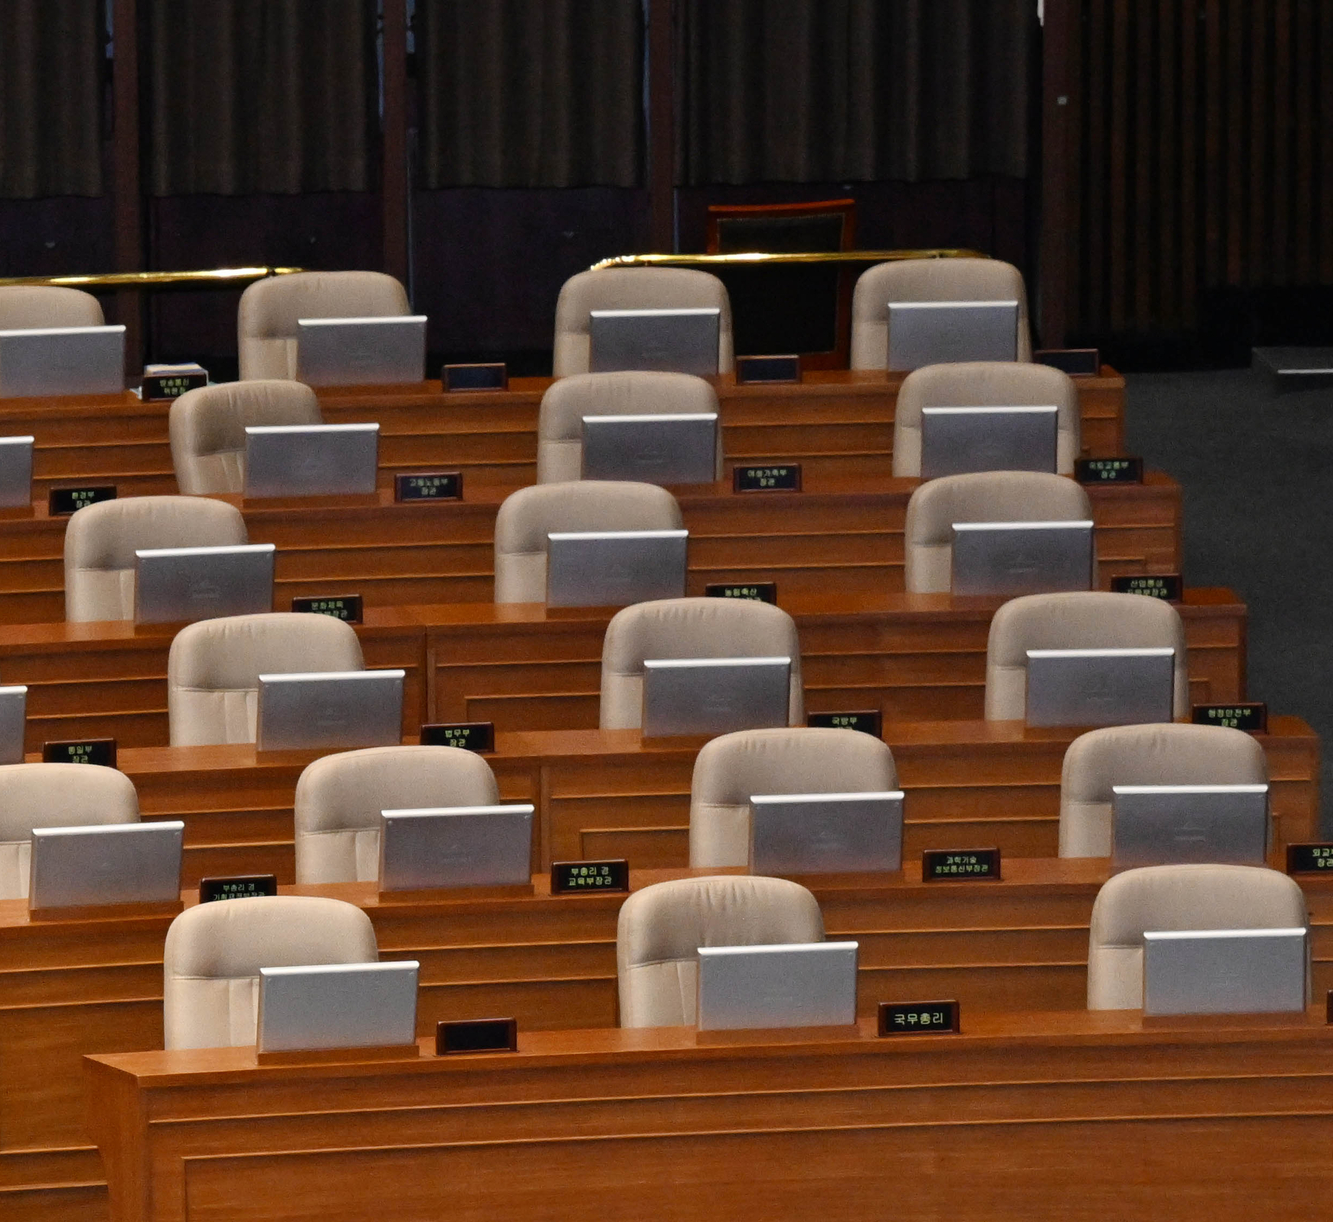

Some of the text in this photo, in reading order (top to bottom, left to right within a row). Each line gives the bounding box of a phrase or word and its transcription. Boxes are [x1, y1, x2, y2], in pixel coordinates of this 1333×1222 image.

[445, 729, 469, 738] 법무부
[1312, 848, 1333, 857] 외교
[571, 867, 597, 876] 부총리
[569, 877, 612, 886] 교육부장관
[894, 1012, 943, 1025] 국무총리
